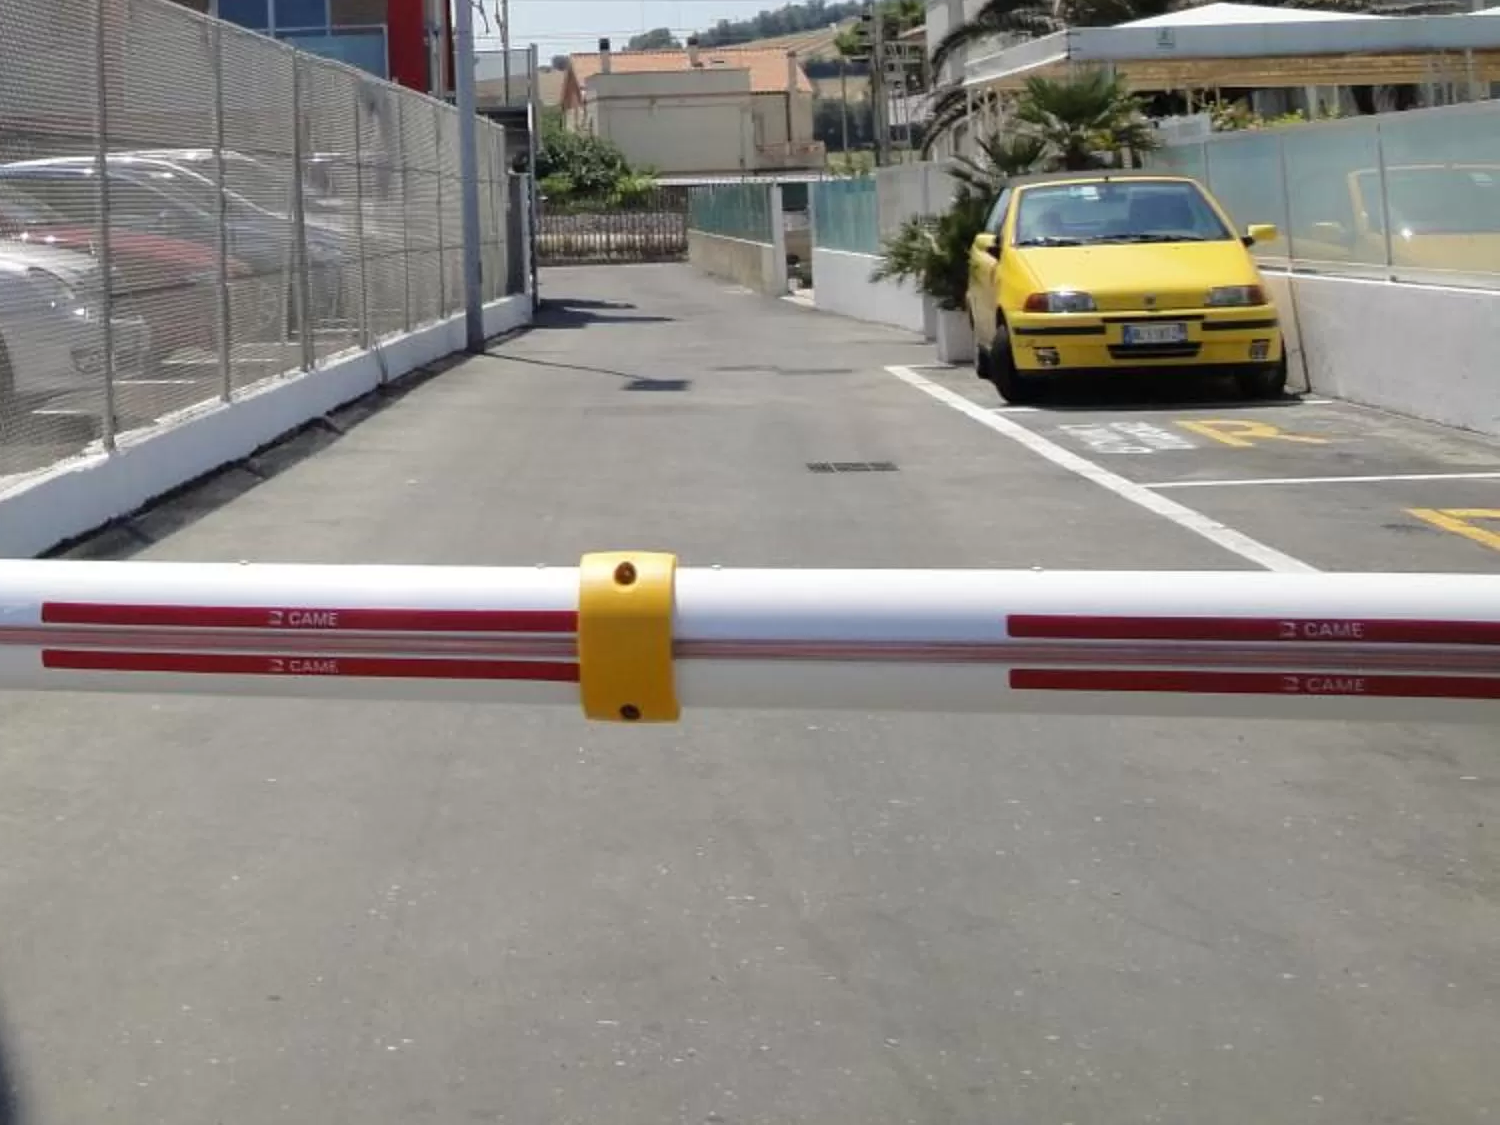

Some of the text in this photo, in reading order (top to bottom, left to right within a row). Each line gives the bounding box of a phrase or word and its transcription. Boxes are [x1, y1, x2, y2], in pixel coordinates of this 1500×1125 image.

[288, 611, 339, 626] CAME
[1303, 622, 1365, 638] CAME
[288, 659, 339, 674] CAME
[1306, 678, 1365, 692] CAME
